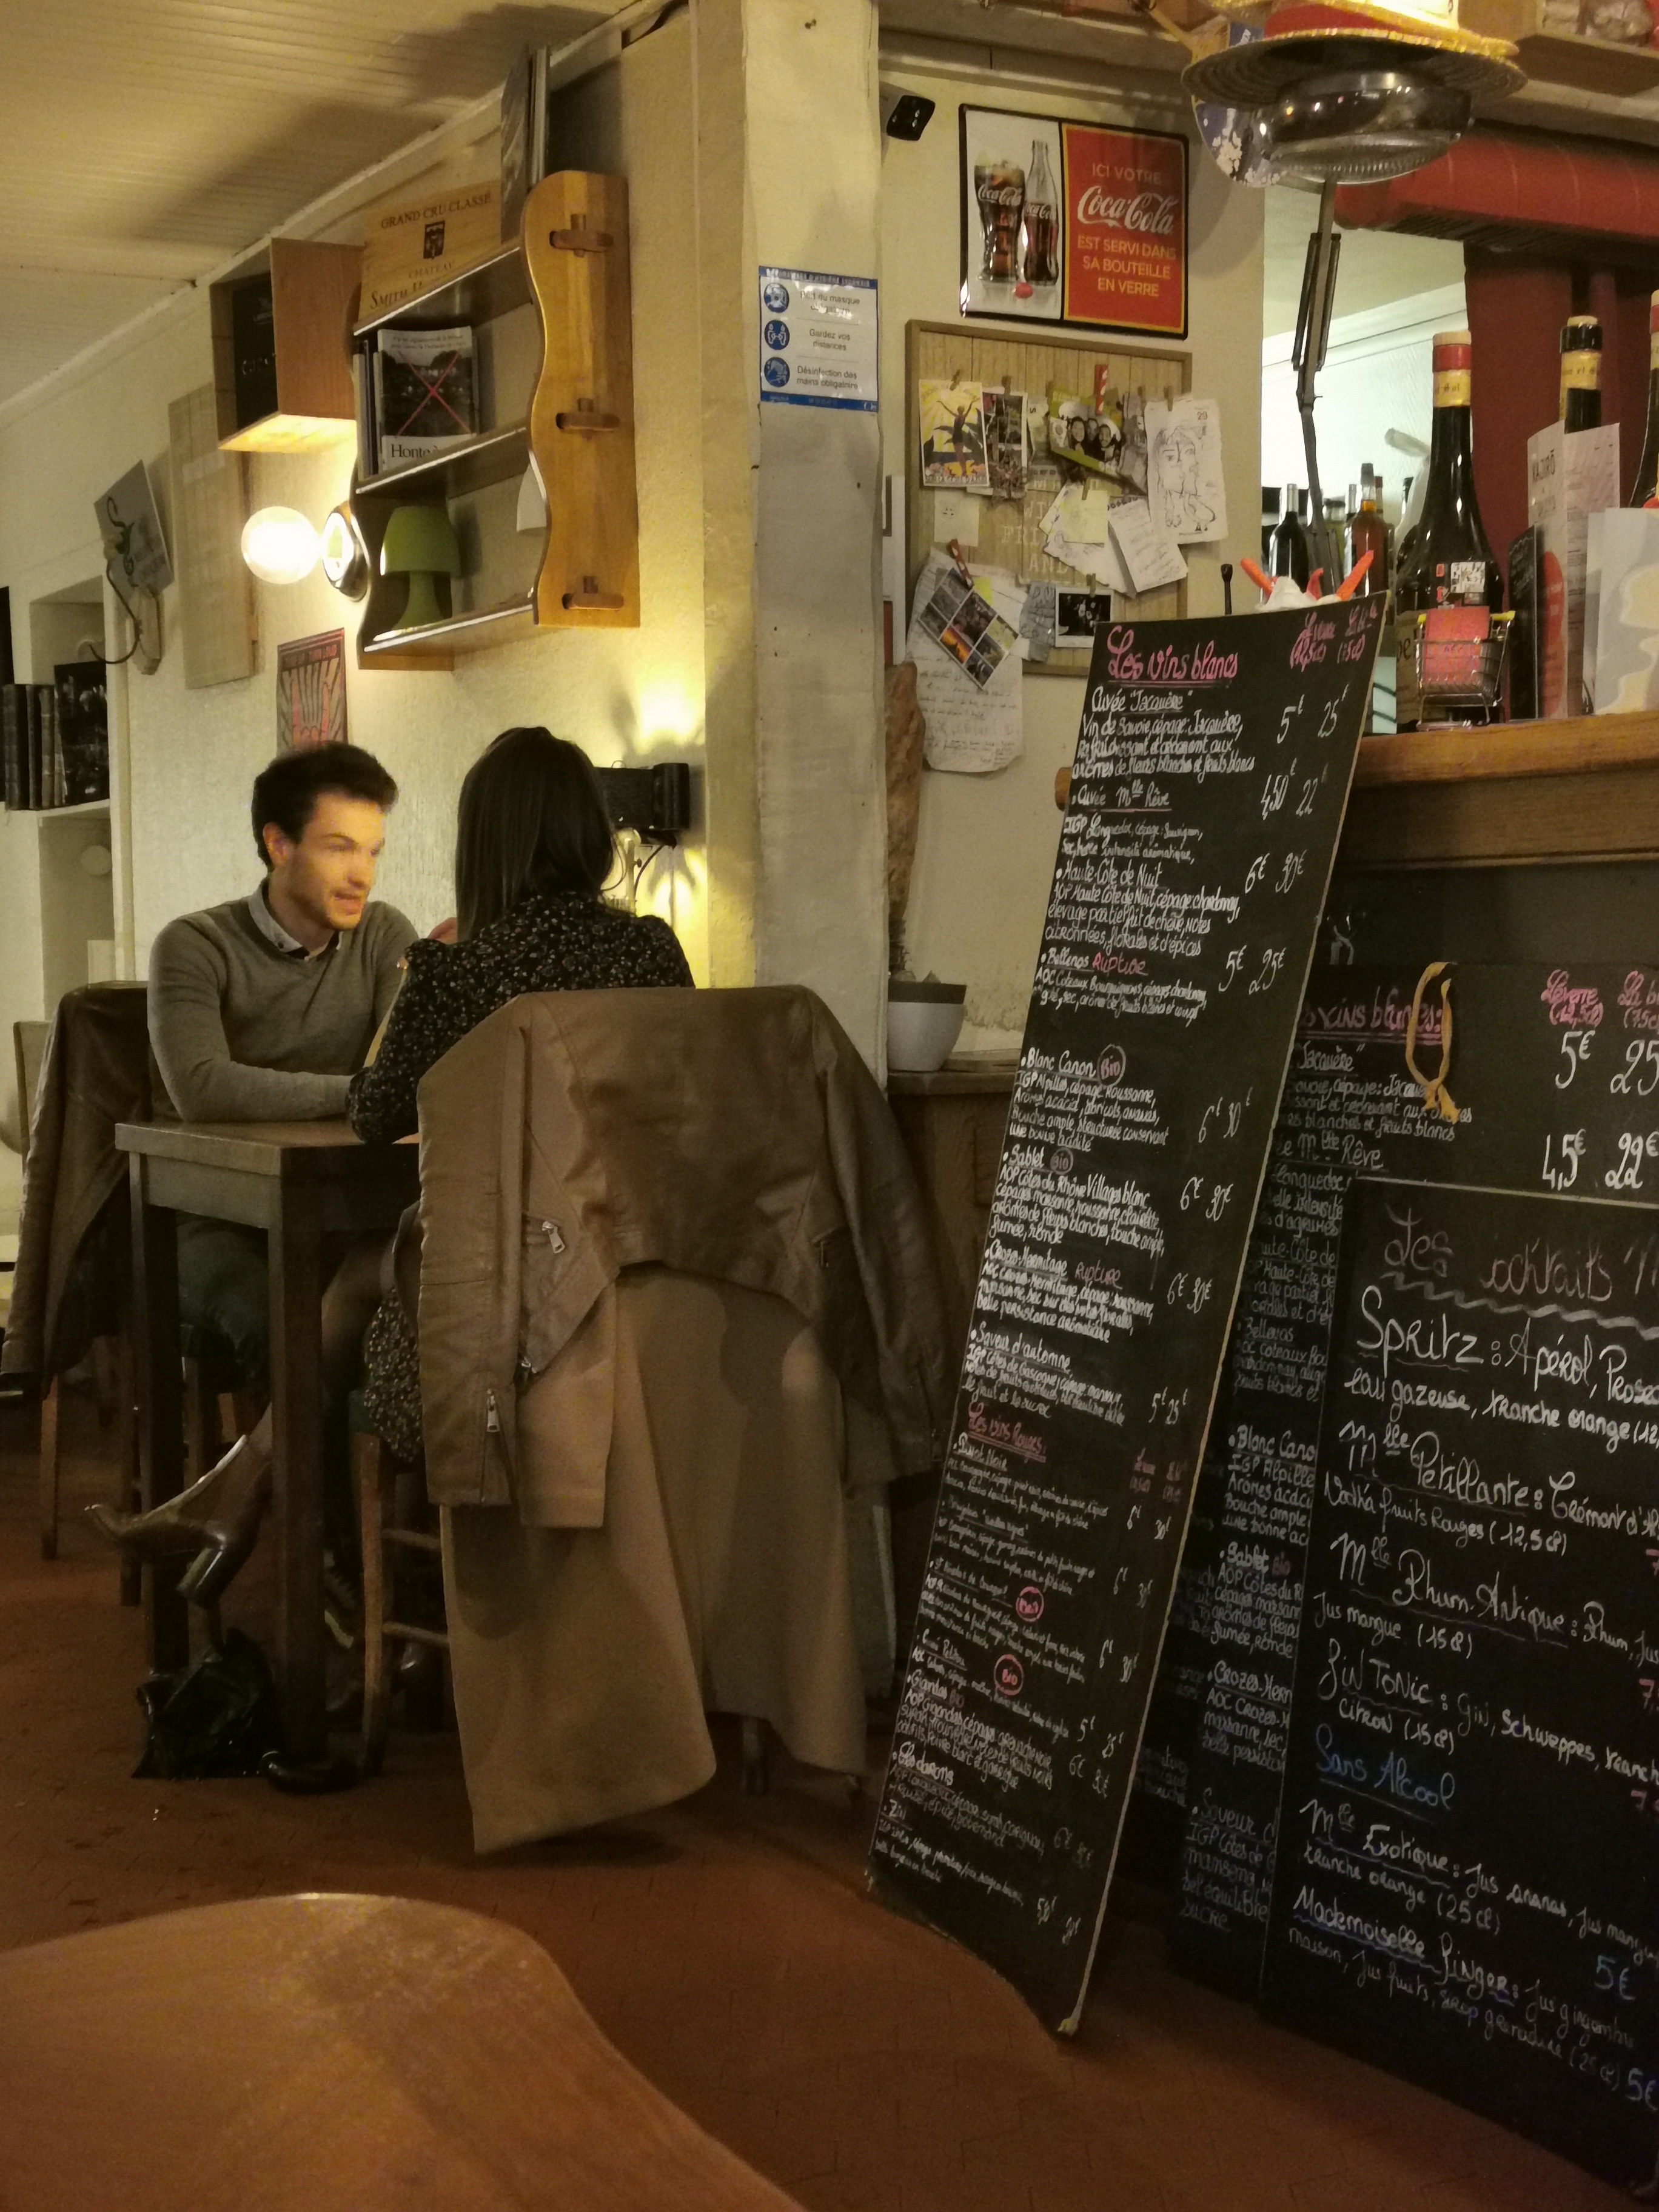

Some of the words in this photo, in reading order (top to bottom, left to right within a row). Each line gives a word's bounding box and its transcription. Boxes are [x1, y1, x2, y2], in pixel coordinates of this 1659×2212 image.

[1092, 163, 1110, 178] ICI
[1114, 166, 1161, 184] VOTRE
[381, 210, 421, 229] GRAND
[423, 204, 446, 218] CRU
[1077, 186, 1179, 235] Coca-Cola
[1078, 235, 1100, 250] EST
[1103, 238, 1139, 255] SERVI
[1142, 243, 1176, 260] DANS
[1082, 256, 1101, 270] SA
[1103, 258, 1170, 280] BOUTEILLE
[1098, 278, 1114, 291] EN
[1118, 279, 1159, 297] VERRE
[809, 329, 836, 340] Gardez
[813, 340, 846, 350] distances
[1107, 626, 1144, 679] Les
[1147, 645, 1190, 680] vins
[1190, 640, 1238, 680] blancs
[1092, 686, 1126, 712] Cuvée
[1082, 714, 1098, 739] Vin
[1101, 714, 1116, 736] de
[1210, 738, 1233, 754] aux
[1078, 785, 1106, 806] Cuvée
[1064, 814, 1088, 834] IGP
[1120, 858, 1134, 885] de
[1136, 860, 1163, 888] Nuit
[1121, 885, 1135, 905] de
[1048, 900, 1088, 929] élevage
[1144, 912, 1155, 928] de
[1148, 932, 1161, 951] et
[1035, 967, 1055, 985] AOC
[1027, 1047, 1054, 1069] Blanc
[1059, 1050, 1097, 1078] Canon
[1101, 1056, 1121, 1079] Bio
[1555, 1030, 1596, 1089] 5€
[1014, 1070, 1038, 1088] IGP
[1364, 1116, 1375, 1131] et
[1414, 1120, 1456, 1142] blancs
[1009, 1144, 1045, 1168] Sablet
[1341, 1134, 1384, 1170] Rêve
[999, 1164, 1019, 1182] AOP
[1041, 1173, 1055, 1192] du
[1121, 1180, 1150, 1209] blanc
[1028, 1204, 1039, 1221] de
[1237, 1424, 1275, 1456] Blanc
[1228, 1454, 1260, 1472] IGP
[1218, 1562, 1244, 1586] AOP
[1278, 1579, 1292, 1600] du
[1252, 1612, 1267, 1631] de
[1206, 1687, 1232, 1710] AOC
[1293, 1885, 1426, 1960] Mademoiselle
[1594, 1954, 1636, 2000] 5€
